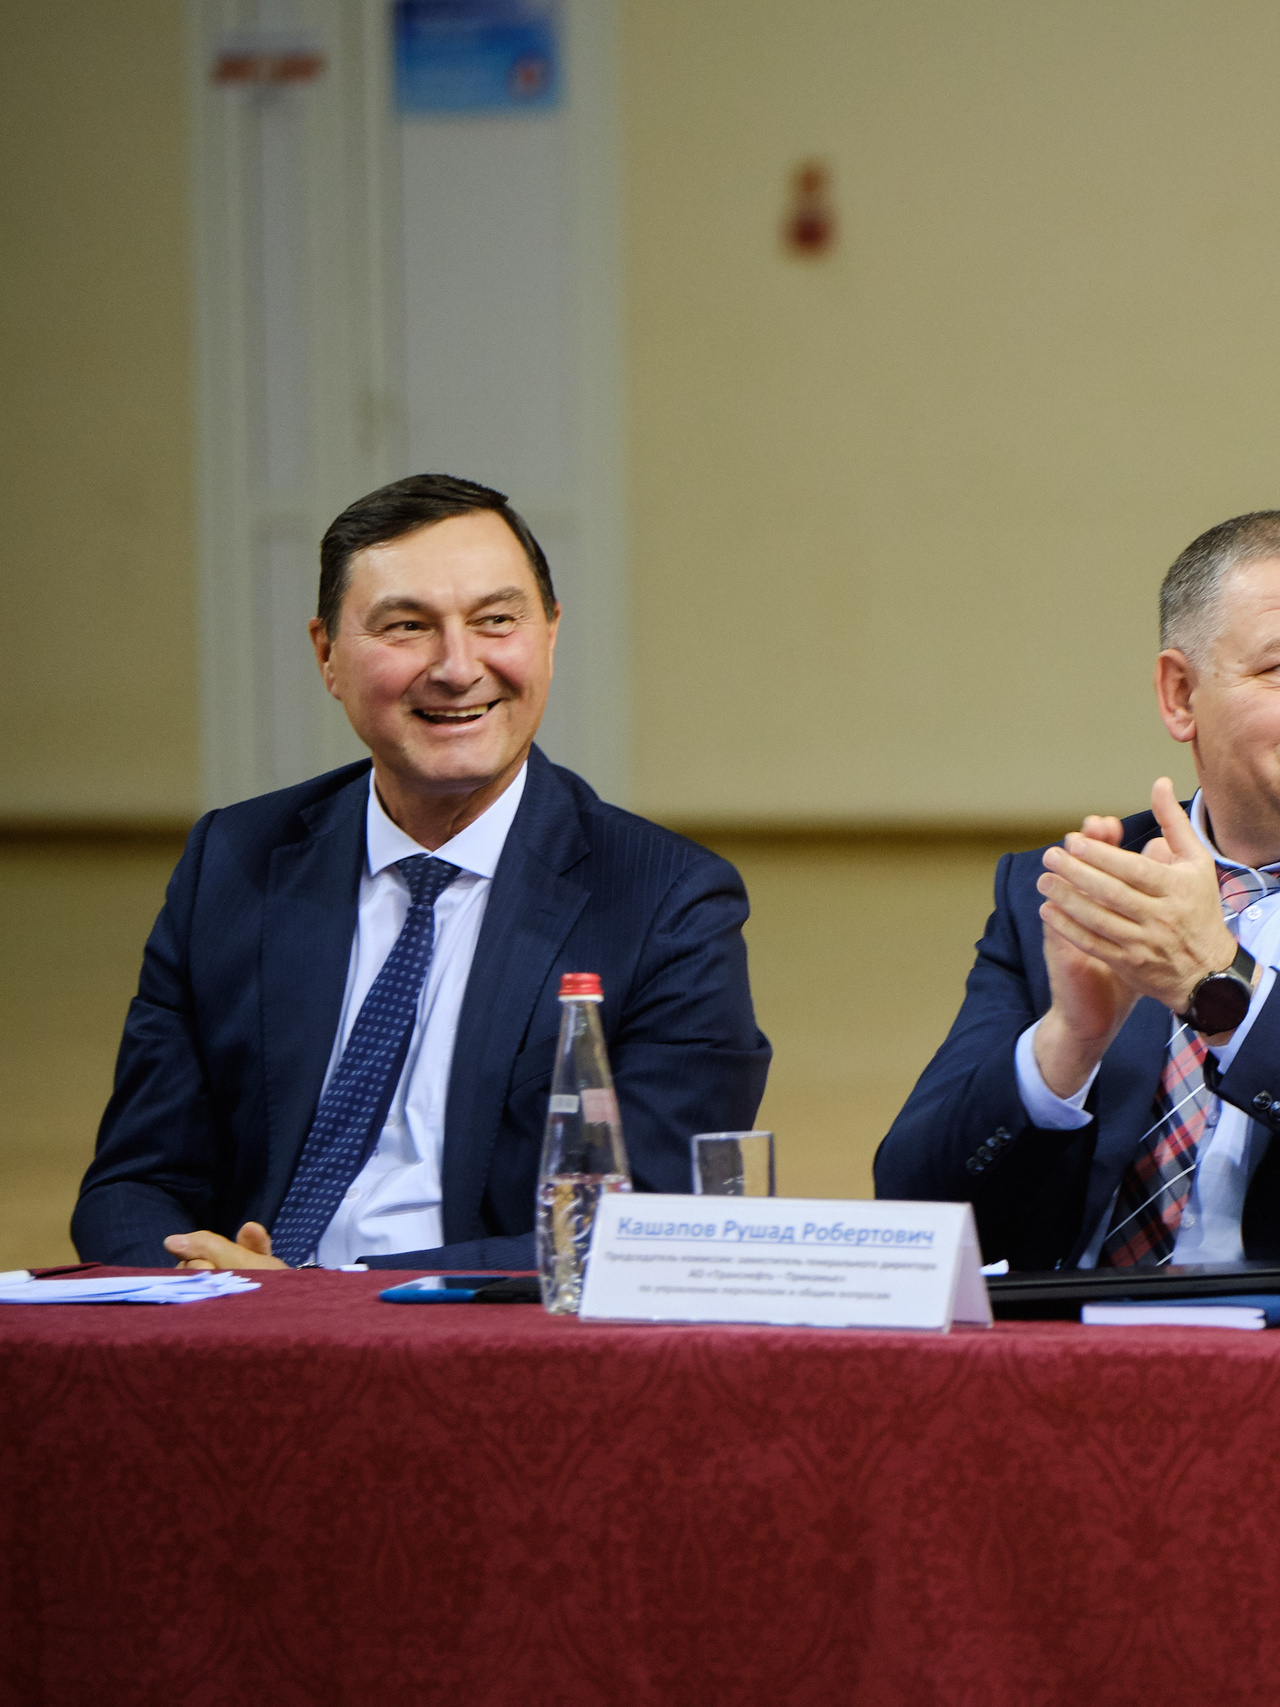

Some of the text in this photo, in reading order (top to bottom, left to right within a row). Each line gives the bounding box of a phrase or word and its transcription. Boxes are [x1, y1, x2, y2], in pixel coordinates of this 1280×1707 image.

[618, 1217, 935, 1246] Кашапов Рушад Робертович
